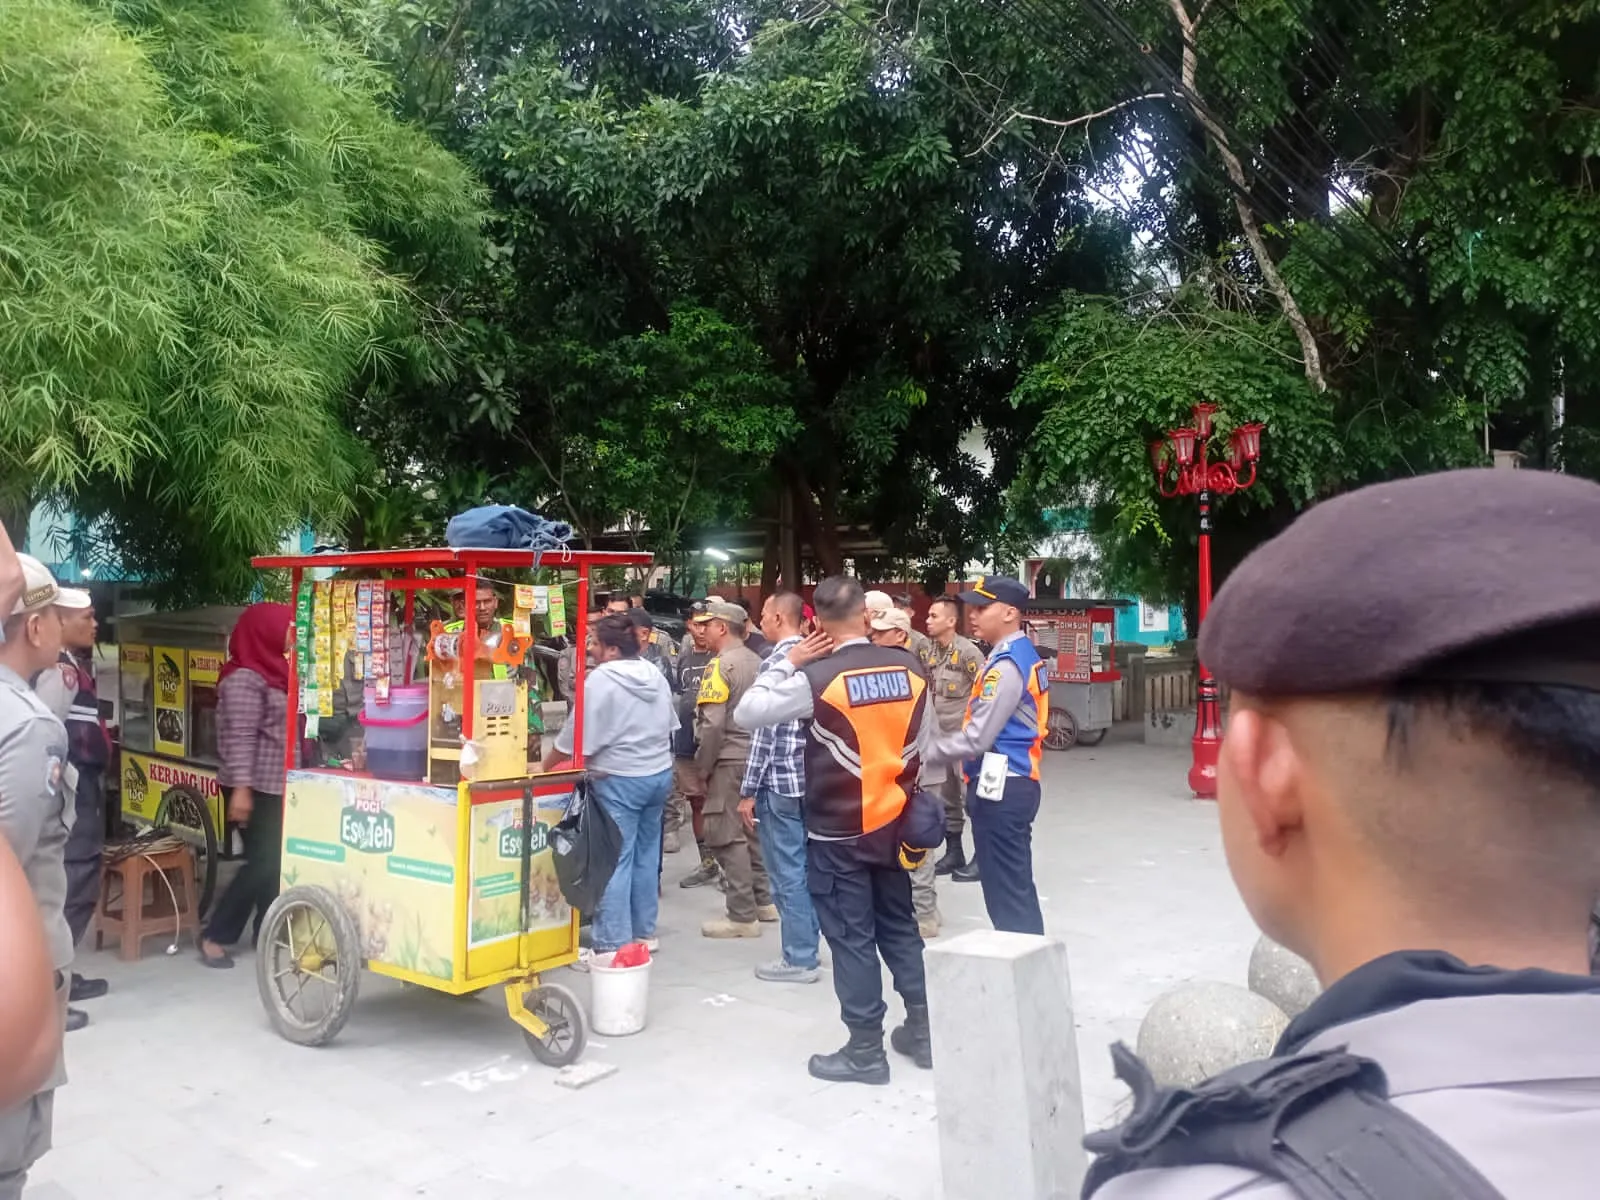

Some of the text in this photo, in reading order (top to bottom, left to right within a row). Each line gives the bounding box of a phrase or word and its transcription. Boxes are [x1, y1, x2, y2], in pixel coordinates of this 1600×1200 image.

[847, 671, 910, 702] DISHUB
[149, 763, 198, 789] KERANG
[201, 776, 219, 799] IJO
[355, 800, 381, 814] POCI
